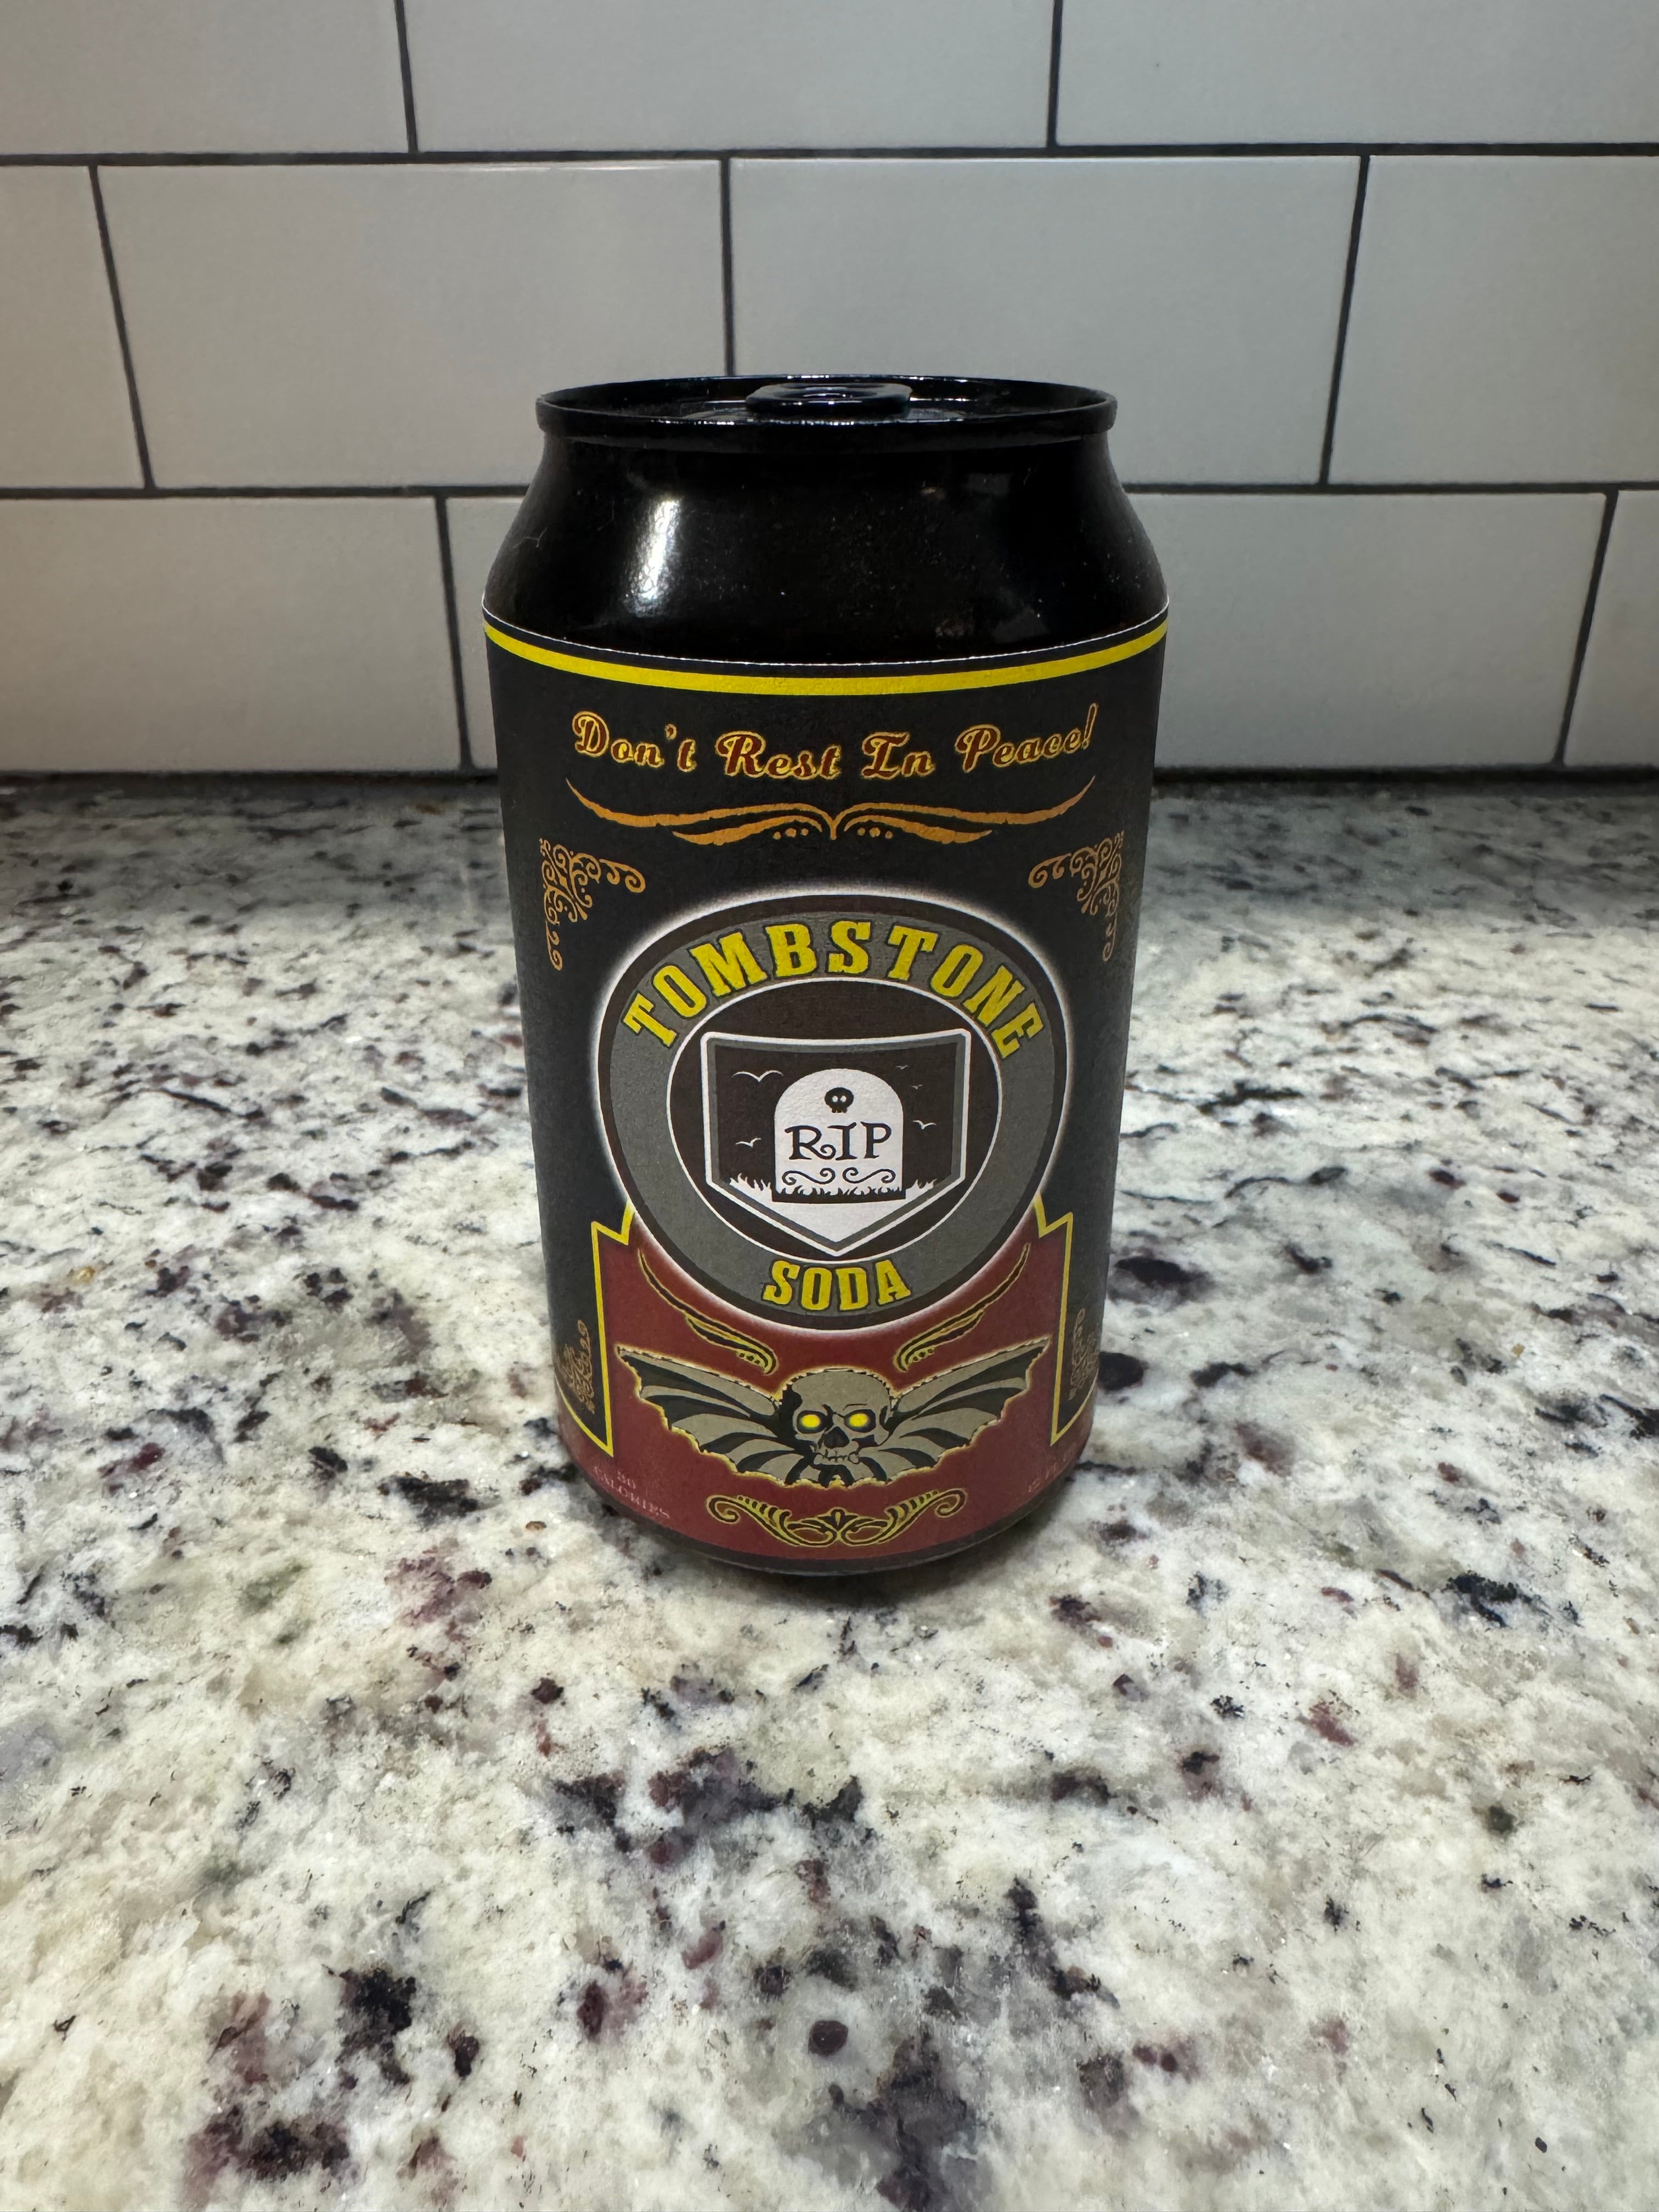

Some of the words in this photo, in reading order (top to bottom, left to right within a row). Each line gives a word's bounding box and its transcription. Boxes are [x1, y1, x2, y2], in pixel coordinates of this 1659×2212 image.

[571, 711, 697, 772] Don't
[715, 730, 843, 780] Rest
[860, 731, 936, 780] In
[954, 703, 1098, 773] Peace!
[621, 920, 1044, 1059] TOMBSTONE
[784, 1121, 892, 1161] RIP
[761, 1259, 912, 1312] SODA
